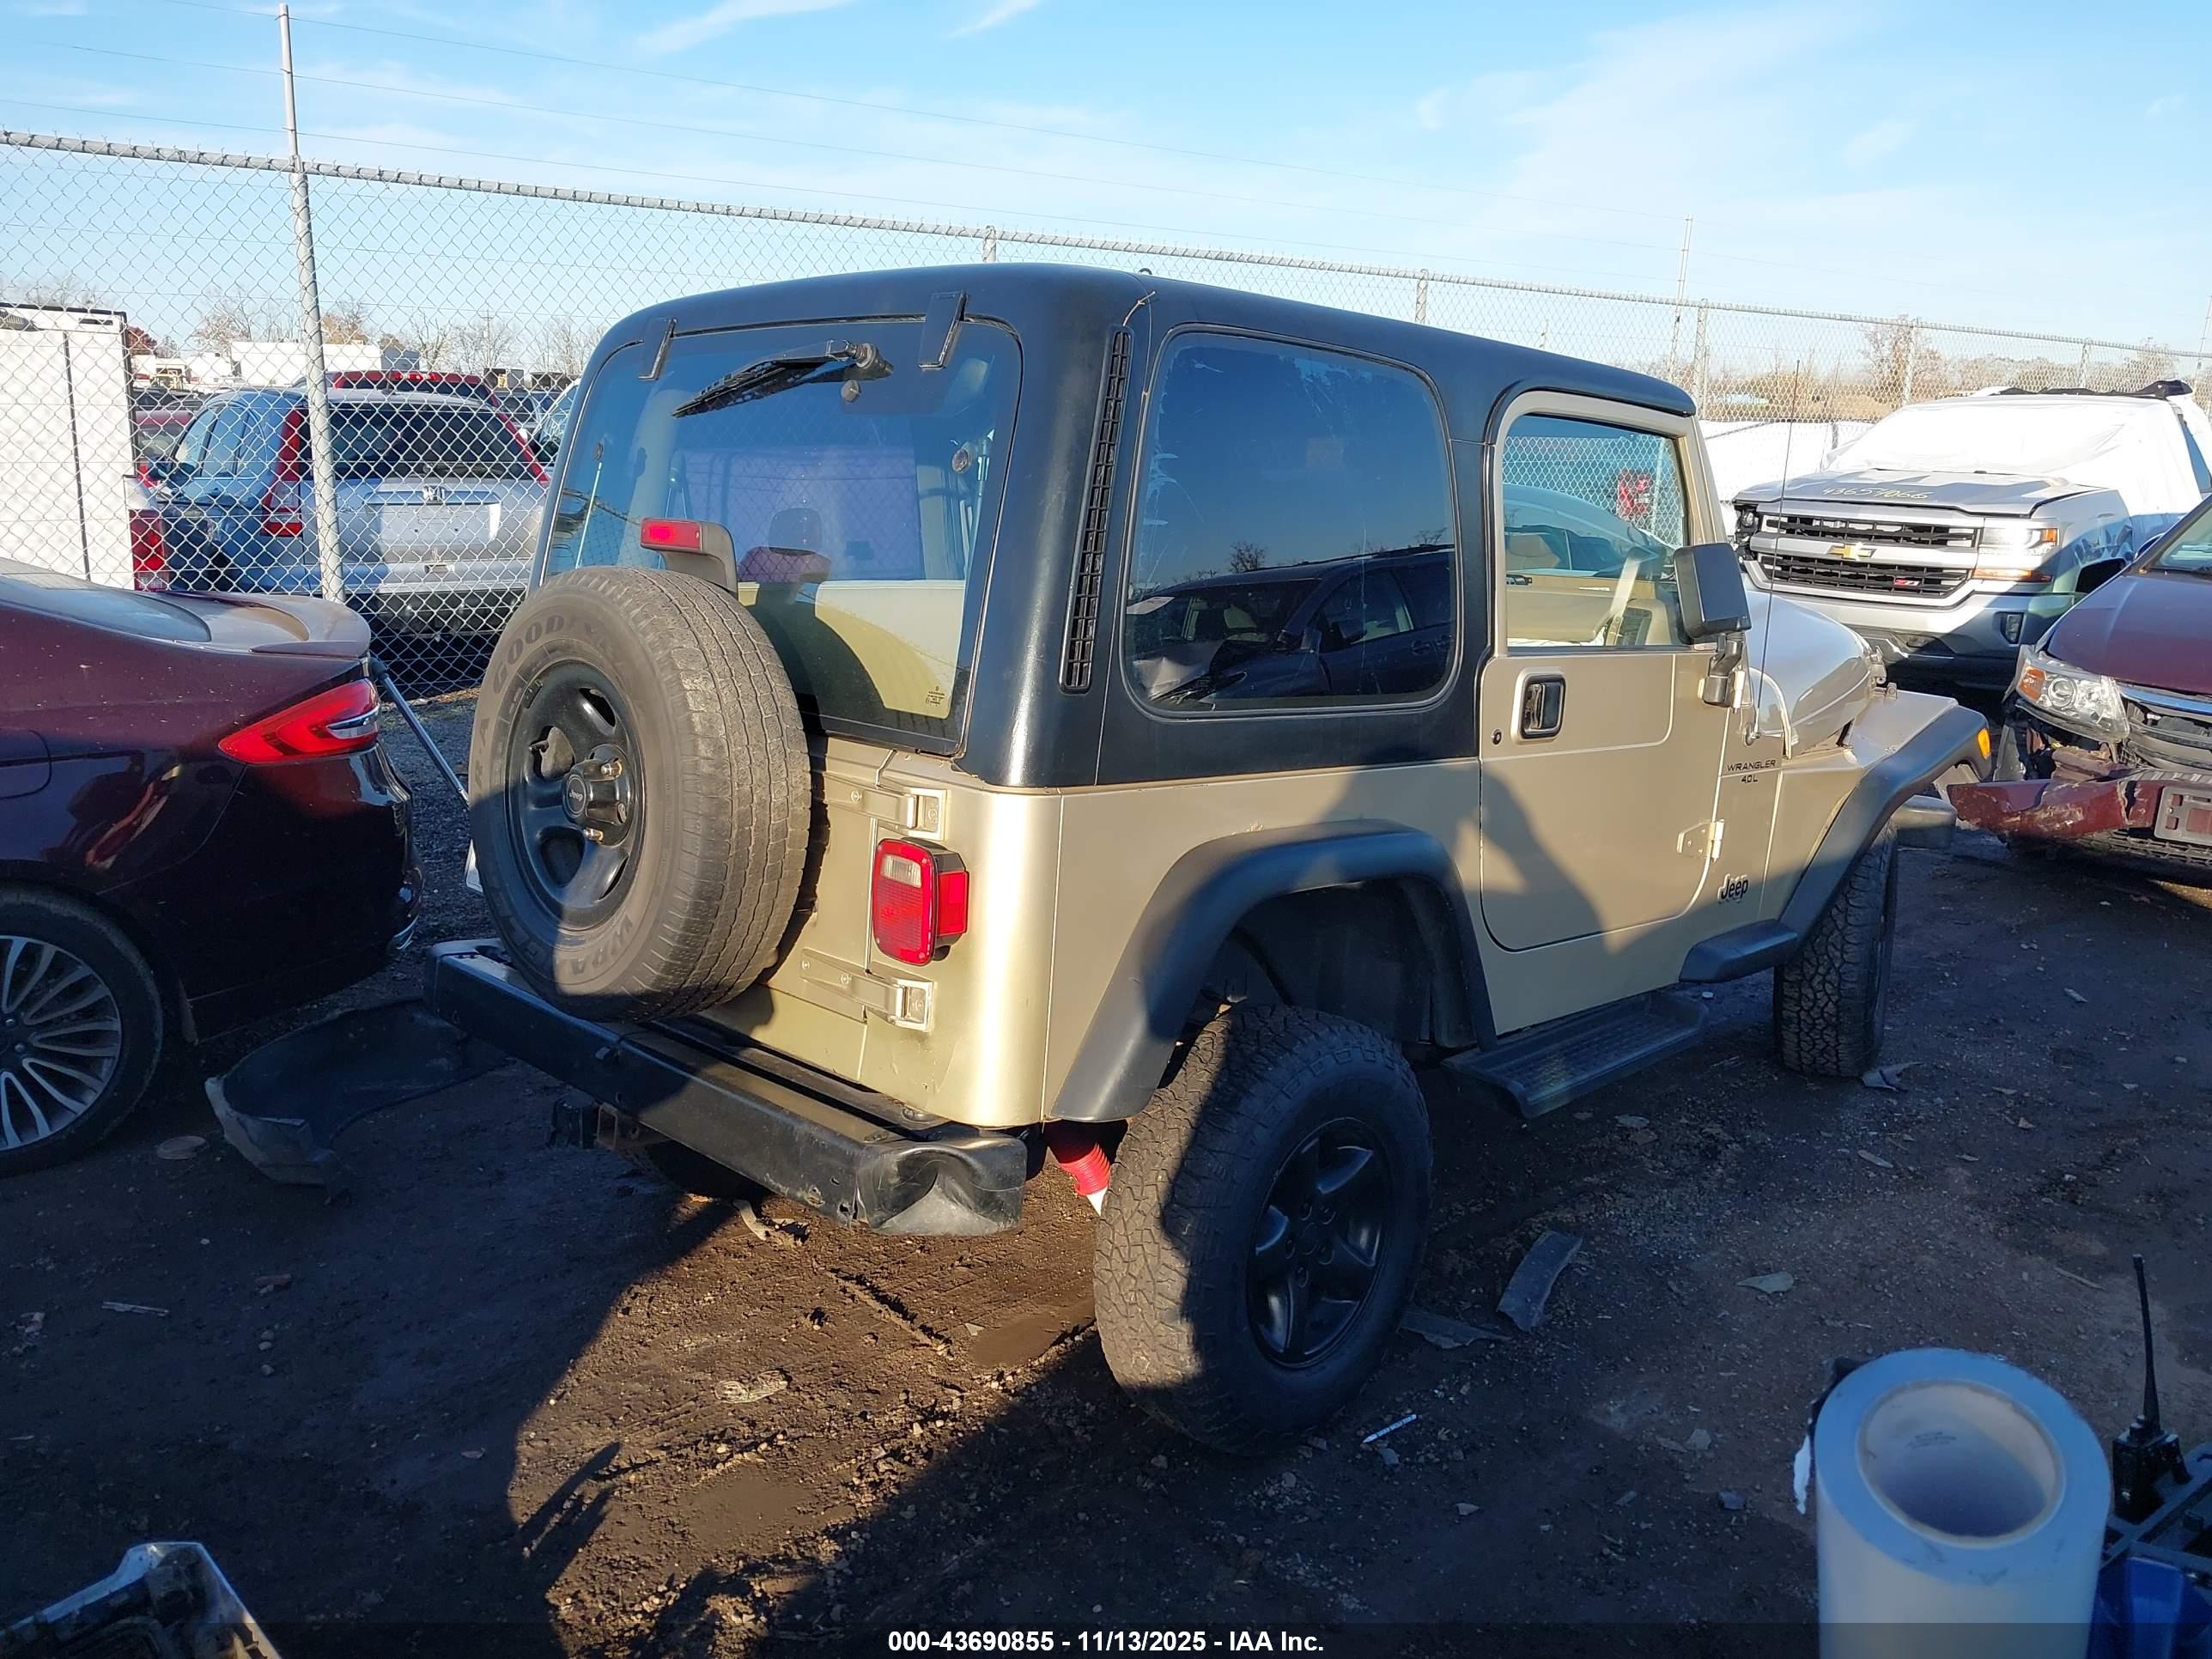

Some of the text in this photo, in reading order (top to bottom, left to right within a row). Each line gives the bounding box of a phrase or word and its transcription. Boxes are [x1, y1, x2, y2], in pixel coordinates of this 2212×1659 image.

[1726, 759, 1776, 772] WRANGLER
[568, 789, 584, 802] Jeep
[1720, 876, 1748, 900] Jeep
